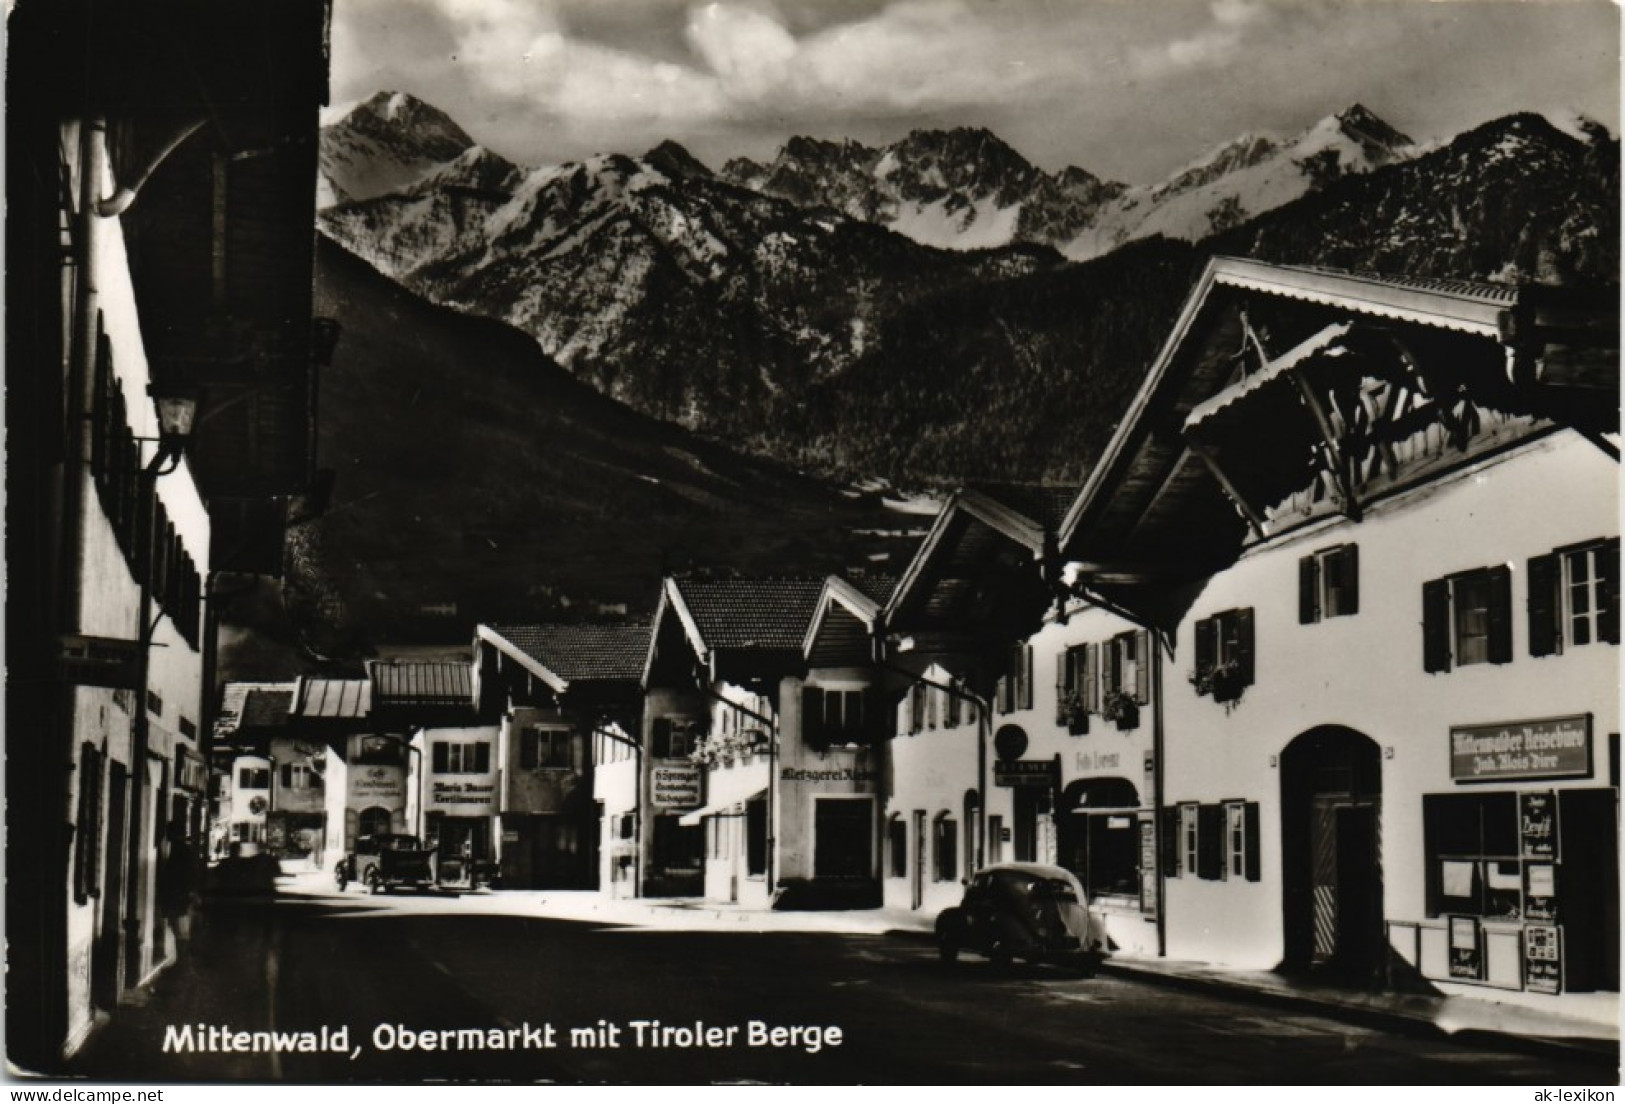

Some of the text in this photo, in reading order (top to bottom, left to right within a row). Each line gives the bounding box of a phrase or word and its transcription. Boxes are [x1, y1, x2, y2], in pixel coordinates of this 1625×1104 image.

[1453, 723, 1584, 755] Mittenwalder Reisebüro
[1498, 753, 1529, 770] Alois
[781, 767, 842, 783] Metzgerei
